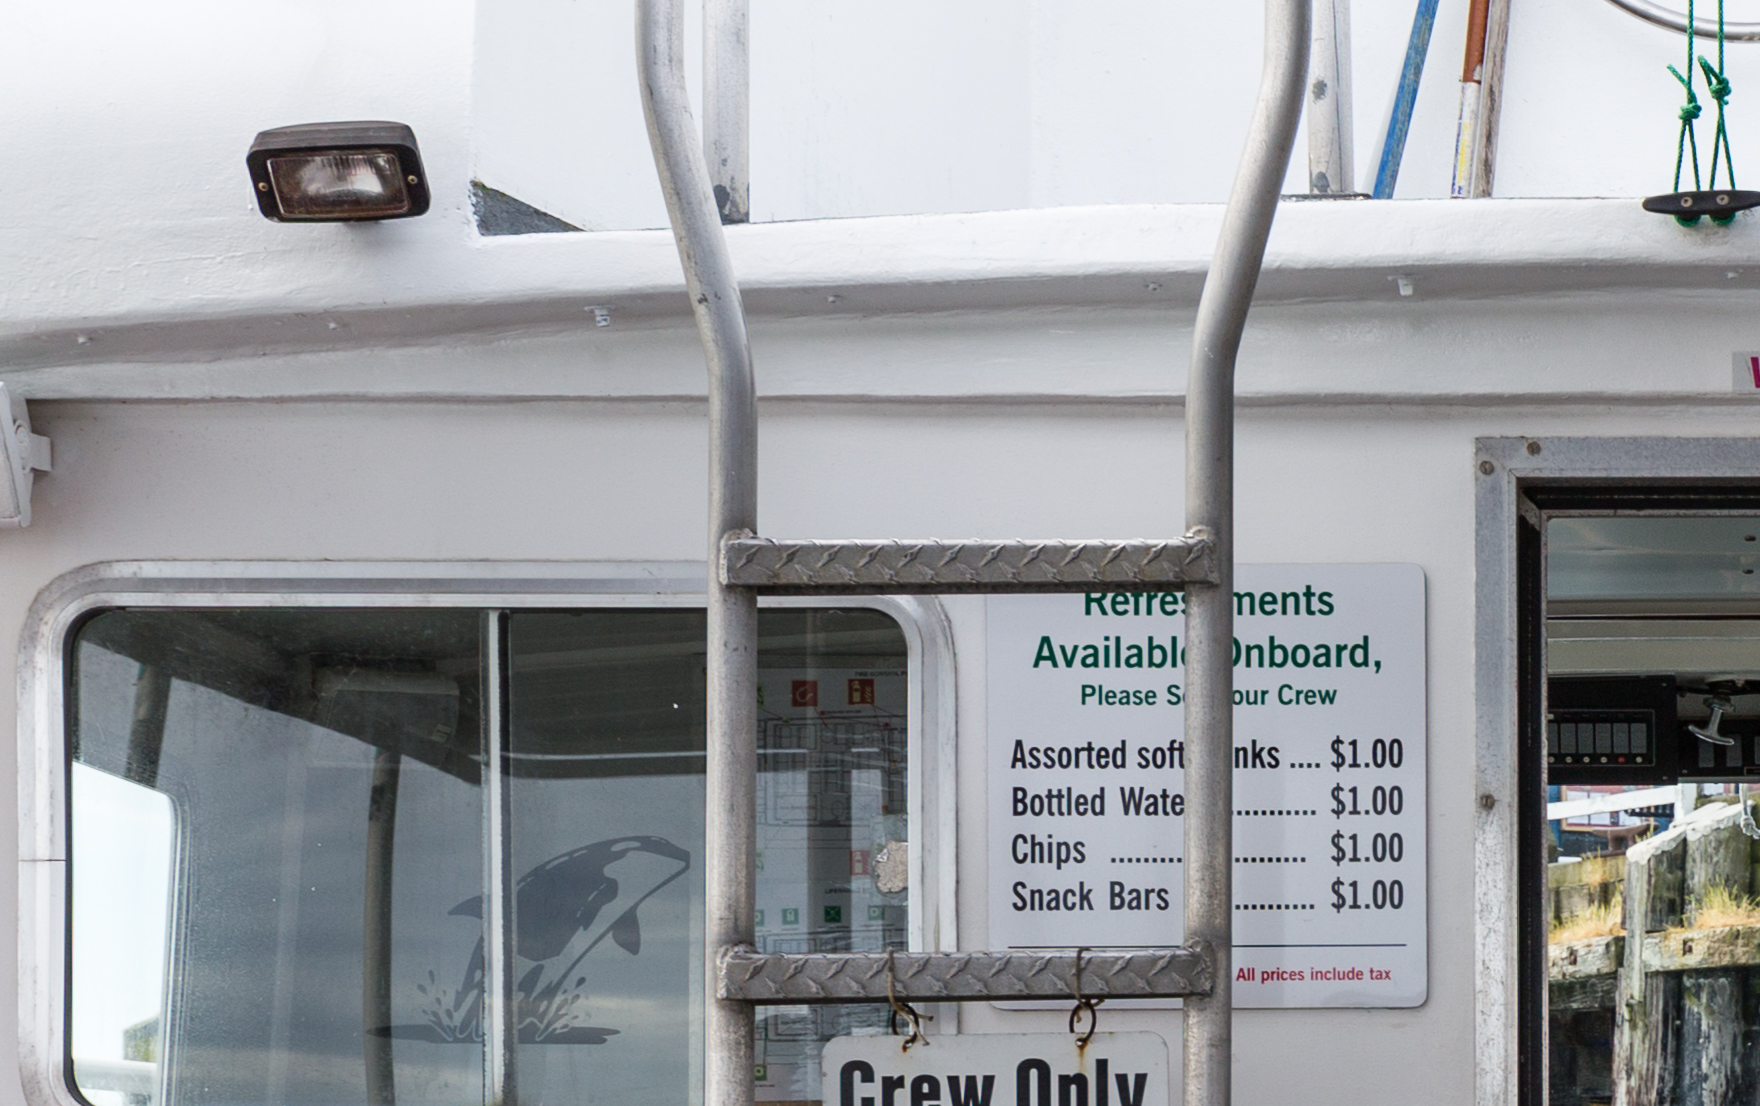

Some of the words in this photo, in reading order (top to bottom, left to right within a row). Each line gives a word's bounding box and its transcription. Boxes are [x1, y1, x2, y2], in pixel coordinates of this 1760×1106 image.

[1084, 585, 1335, 616] Refrements
[1033, 635, 1186, 669] Availabl
[1232, 635, 1382, 674] nboard,
[1081, 684, 1157, 706] Please
[1233, 688, 1269, 706] our
[1277, 684, 1337, 706] Crew
[1011, 738, 1126, 769] Assorted
[1137, 738, 1185, 769] soft
[1234, 739, 1280, 769] nks
[1330, 735, 1403, 771] $1.00
[1012, 786, 1105, 817] Bottled
[1120, 786, 1185, 817] Wate
[1330, 782, 1403, 818] $1.00
[1012, 833, 1086, 870] Chips
[1330, 829, 1403, 865] $1.00
[1012, 881, 1094, 911] Snack
[1109, 881, 1170, 911] Bars
[1330, 877, 1403, 913] $1.00
[1236, 967, 1255, 982] All
[1261, 967, 1304, 984] prices
[1310, 967, 1363, 981] include
[1370, 968, 1391, 981] tax
